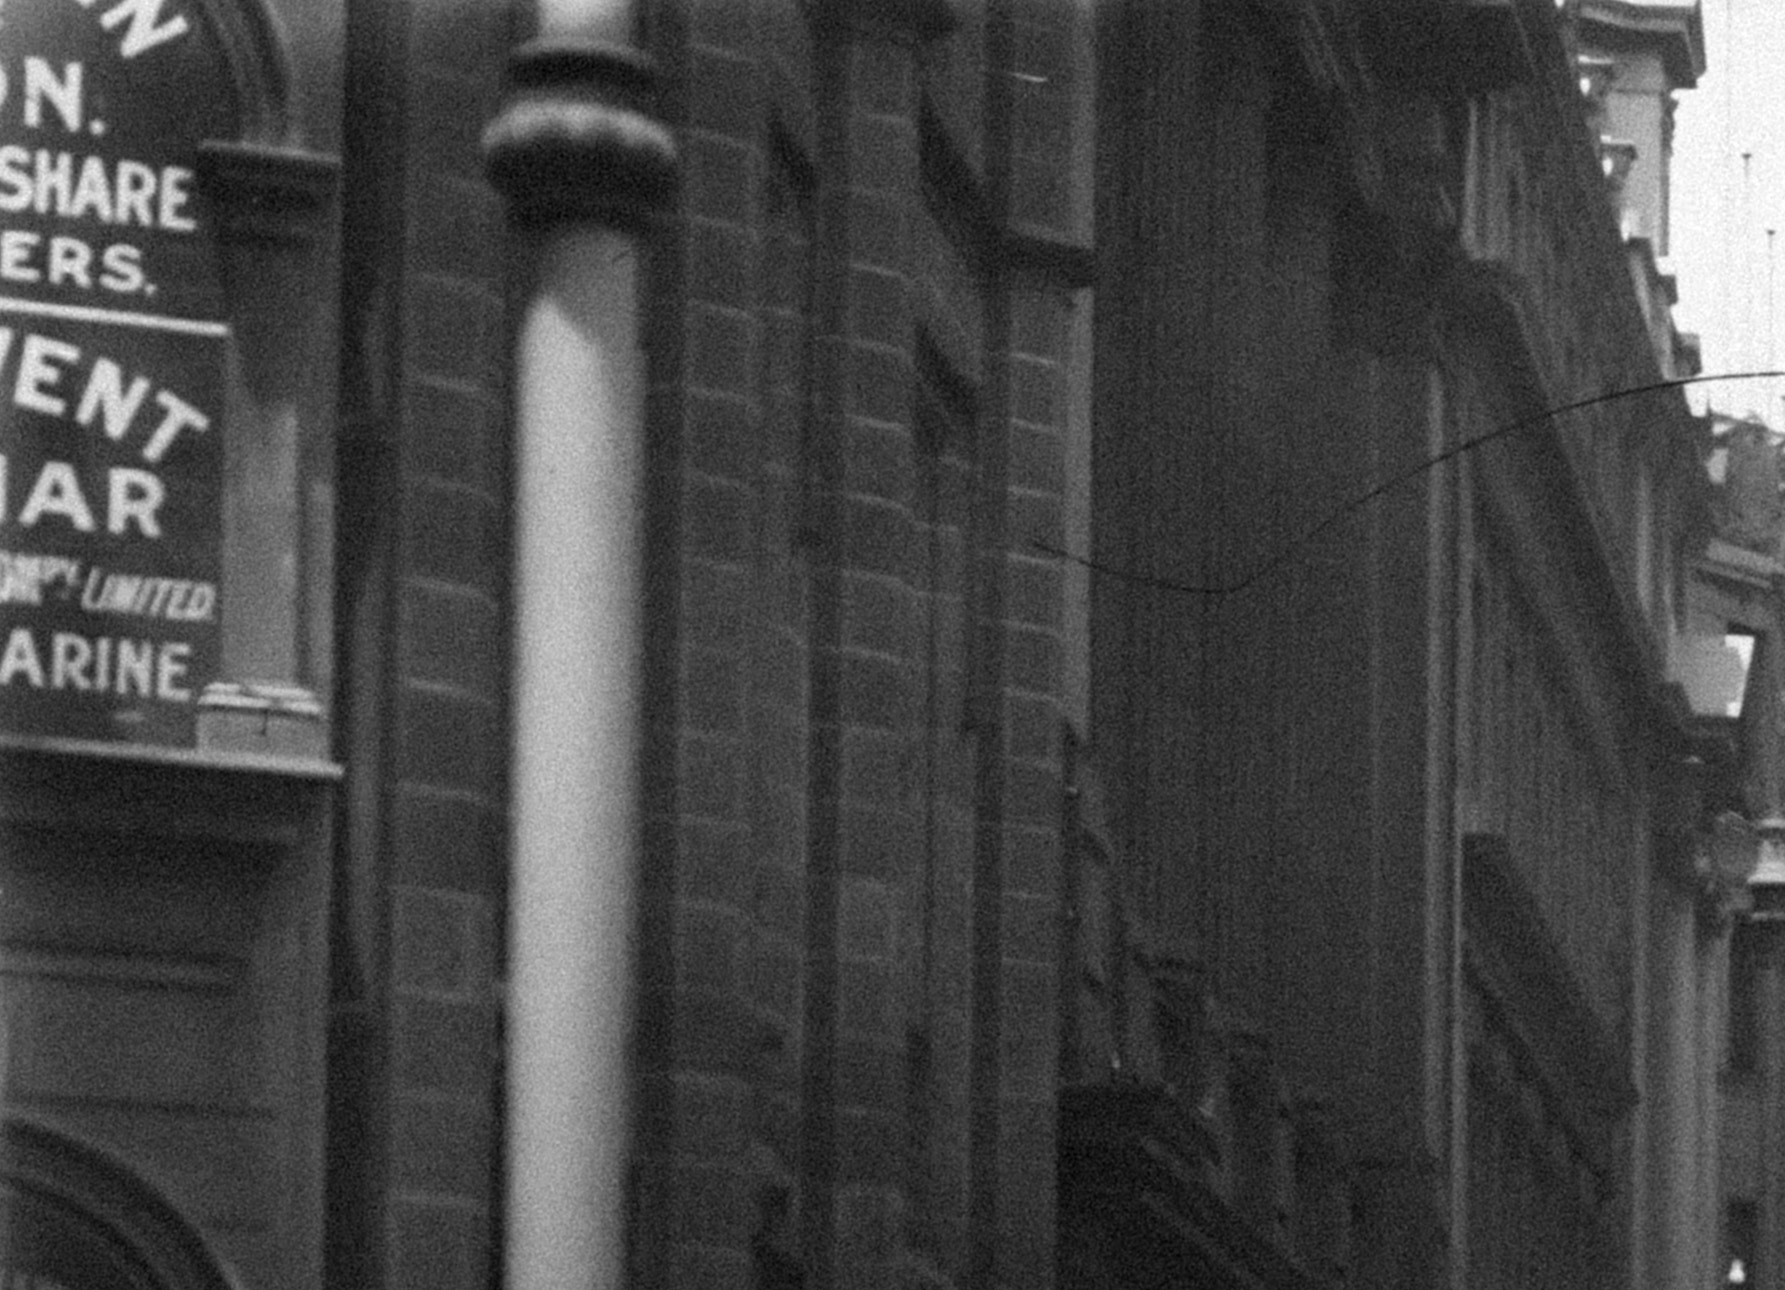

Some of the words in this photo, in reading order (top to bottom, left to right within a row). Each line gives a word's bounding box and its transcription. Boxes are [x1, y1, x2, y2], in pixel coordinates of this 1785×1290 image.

[0, 56, 106, 134] N.
[0, 145, 197, 231] SHARE
[0, 326, 208, 463] ENT
[0, 455, 166, 537] AR
[81, 568, 217, 624] LIMITED
[0, 627, 193, 702] ARINE
